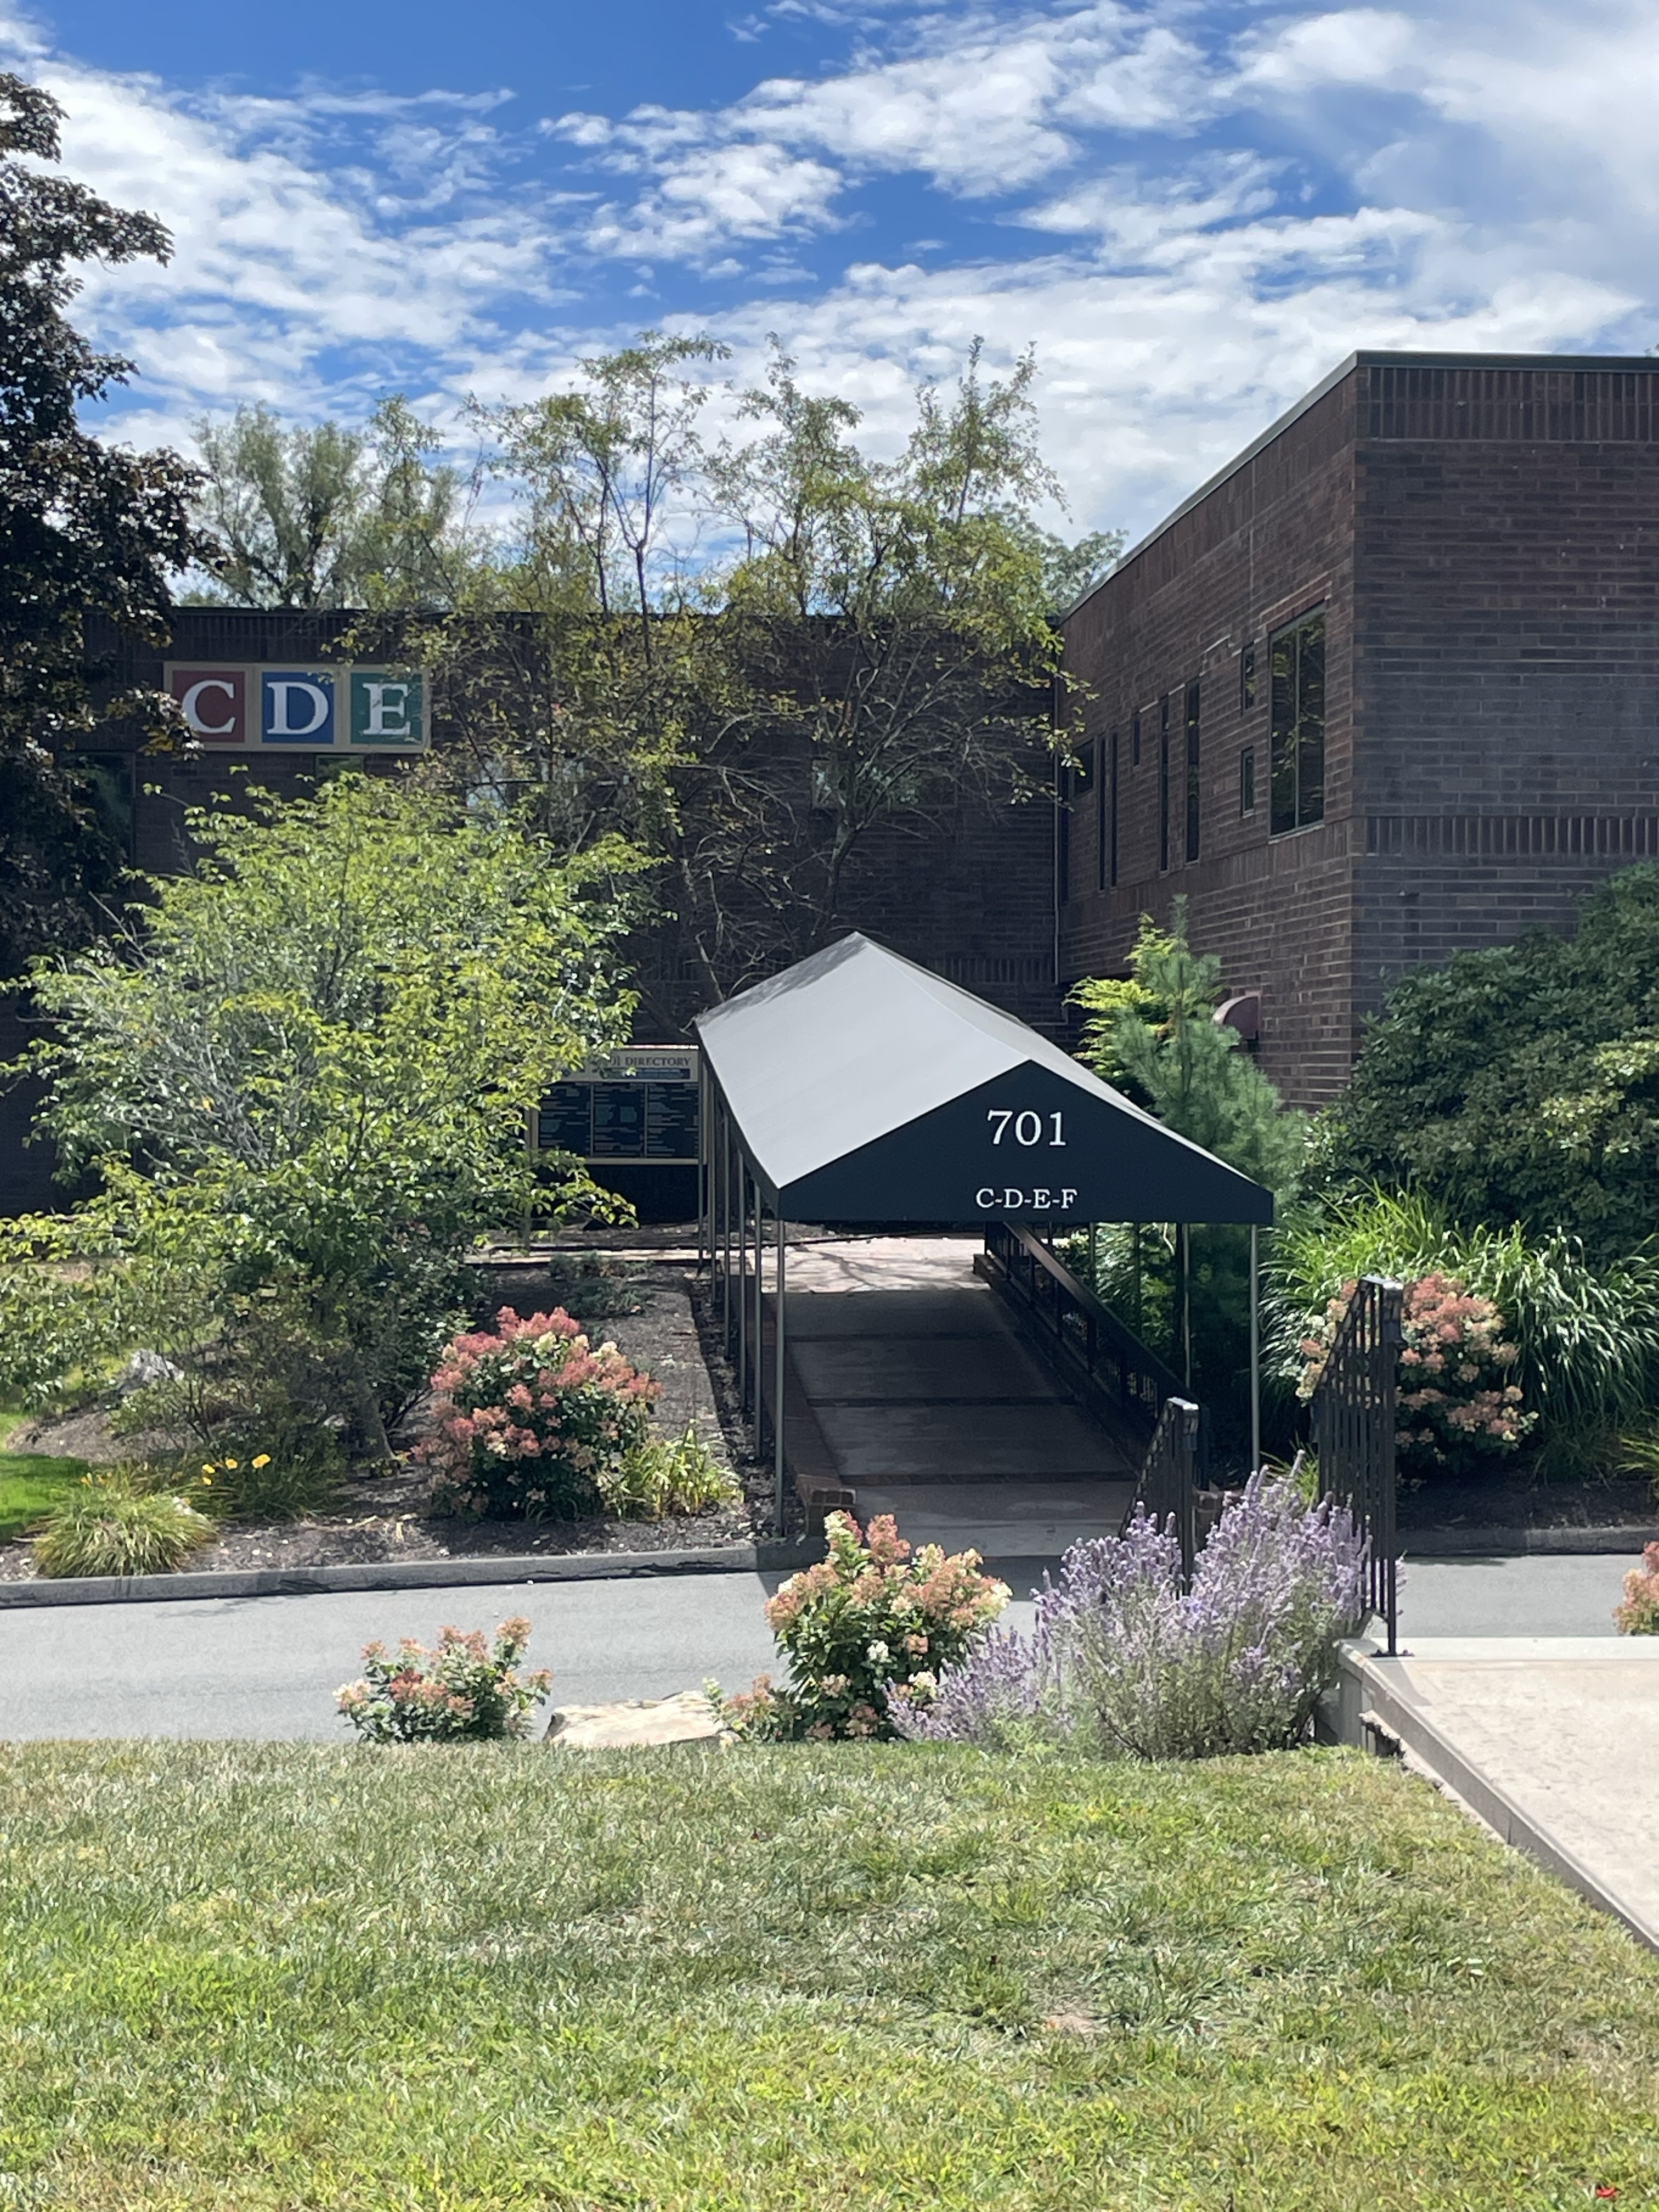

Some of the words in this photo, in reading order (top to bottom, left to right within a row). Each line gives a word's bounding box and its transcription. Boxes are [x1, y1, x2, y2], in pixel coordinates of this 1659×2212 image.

[182, 680, 236, 733] C
[266, 681, 329, 735] D
[363, 682, 411, 736] E
[625, 1057, 691, 1066] DIRECTORY
[987, 1109, 1066, 1146] 701
[975, 1188, 1078, 1209] C-D-E-F
